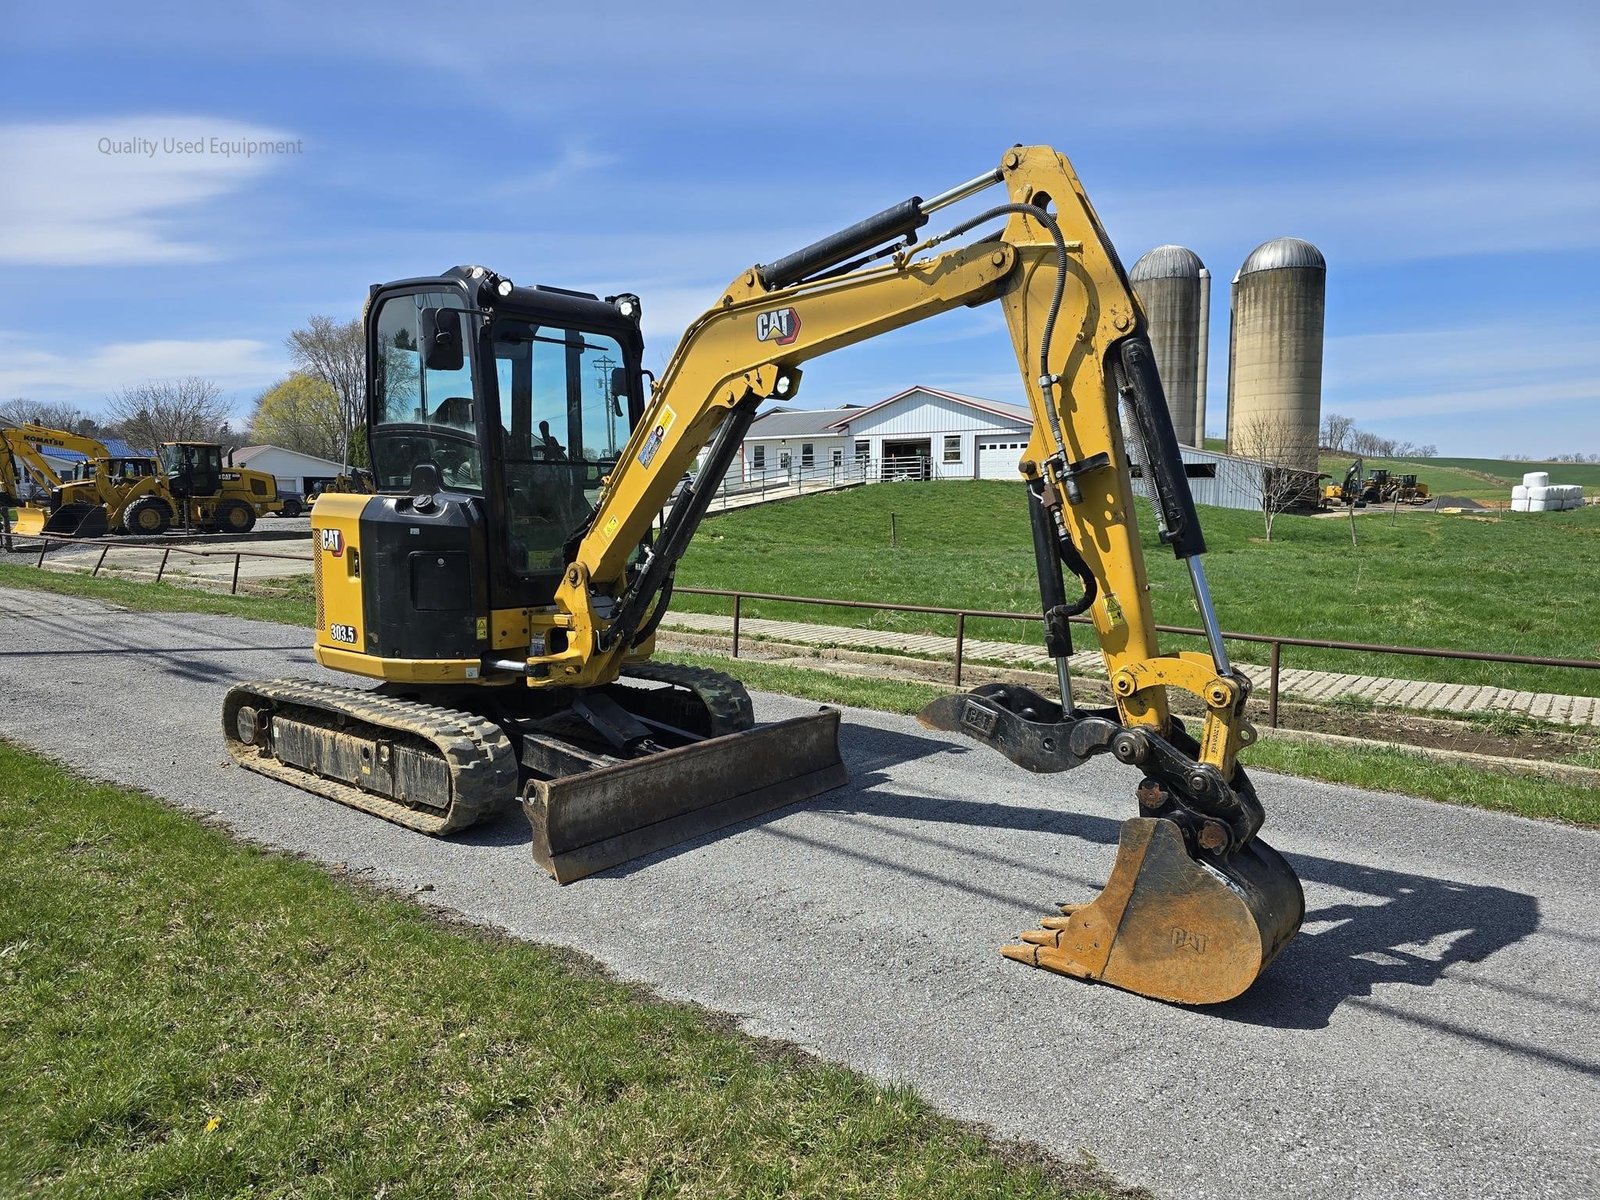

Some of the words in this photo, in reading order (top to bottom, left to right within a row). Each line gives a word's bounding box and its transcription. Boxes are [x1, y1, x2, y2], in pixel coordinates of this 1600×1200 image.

[757, 308, 790, 341] CAT
[23, 434, 65, 447] KOMATSU
[322, 529, 340, 551] CAT
[331, 624, 354, 643] 303.5
